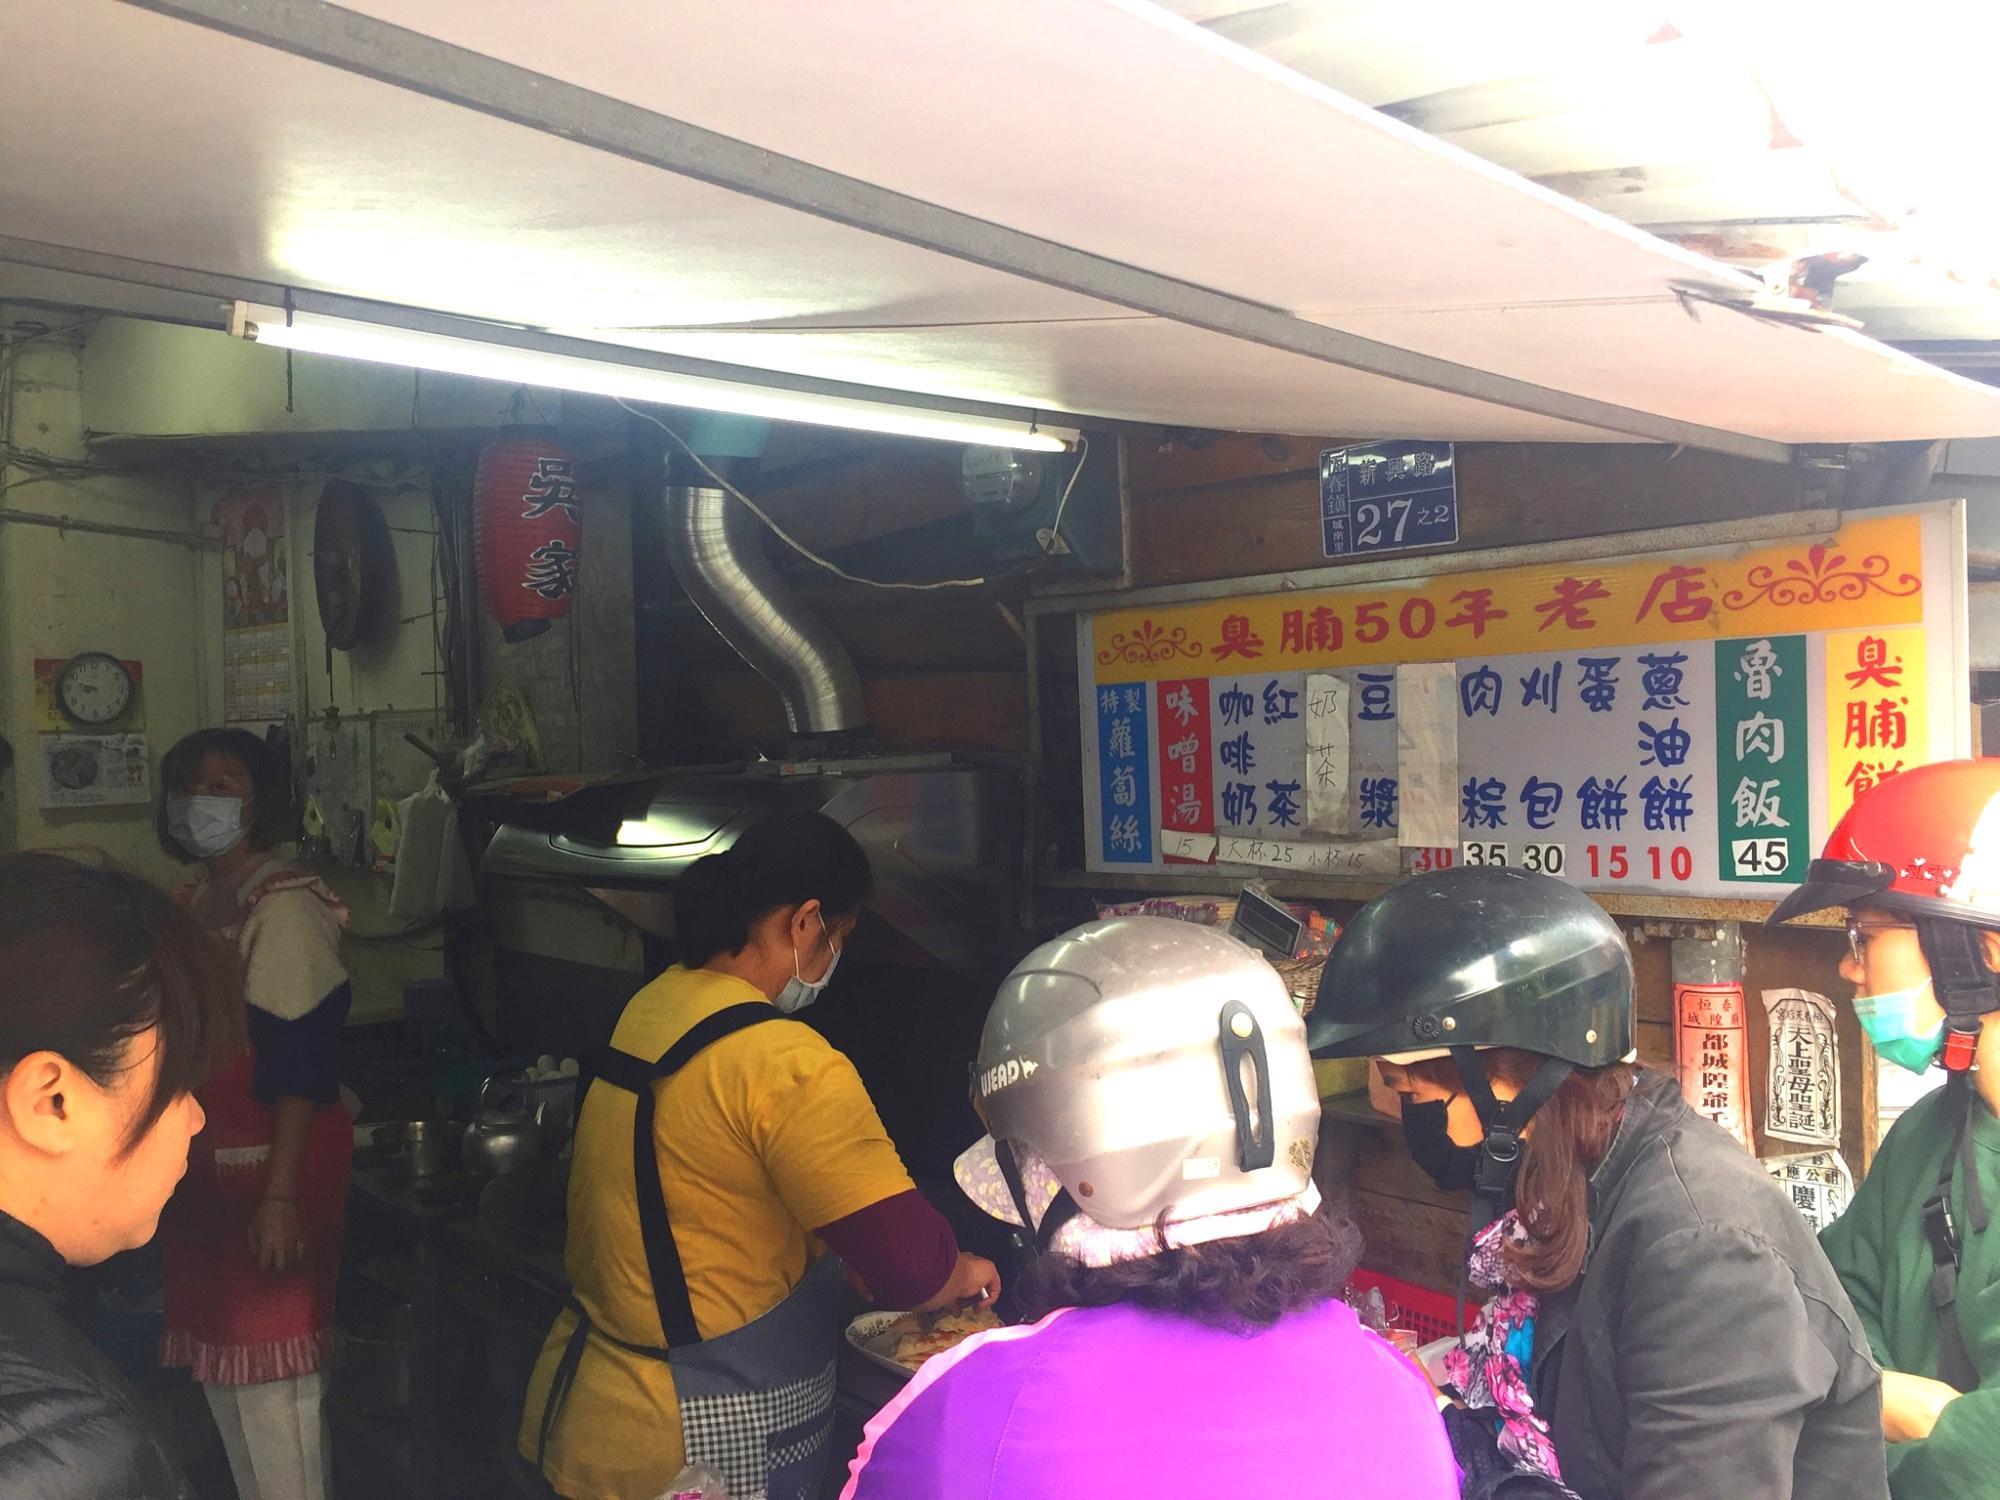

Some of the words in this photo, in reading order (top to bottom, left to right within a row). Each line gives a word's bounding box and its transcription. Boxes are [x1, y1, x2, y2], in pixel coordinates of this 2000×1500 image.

[521, 456, 580, 599] 吳家
[1100, 687, 1143, 714] 特製
[1308, 689, 1338, 788] 奶茶
[1356, 672, 1398, 830] 豆漿
[1519, 659, 1564, 831] 刈包
[1576, 656, 1629, 832] 蛋餅
[1731, 638, 1791, 829] 魯肉飯
[1175, 837, 1195, 855] 15
[1413, 846, 1453, 872] 30
[1465, 842, 1507, 867] 35
[1523, 844, 1563, 874] 30
[1586, 845, 1629, 879] 15
[1647, 845, 1692, 881] 10
[1737, 840, 1787, 873] 45
[1787, 1026, 1816, 1132] 天上聖母聖誕
